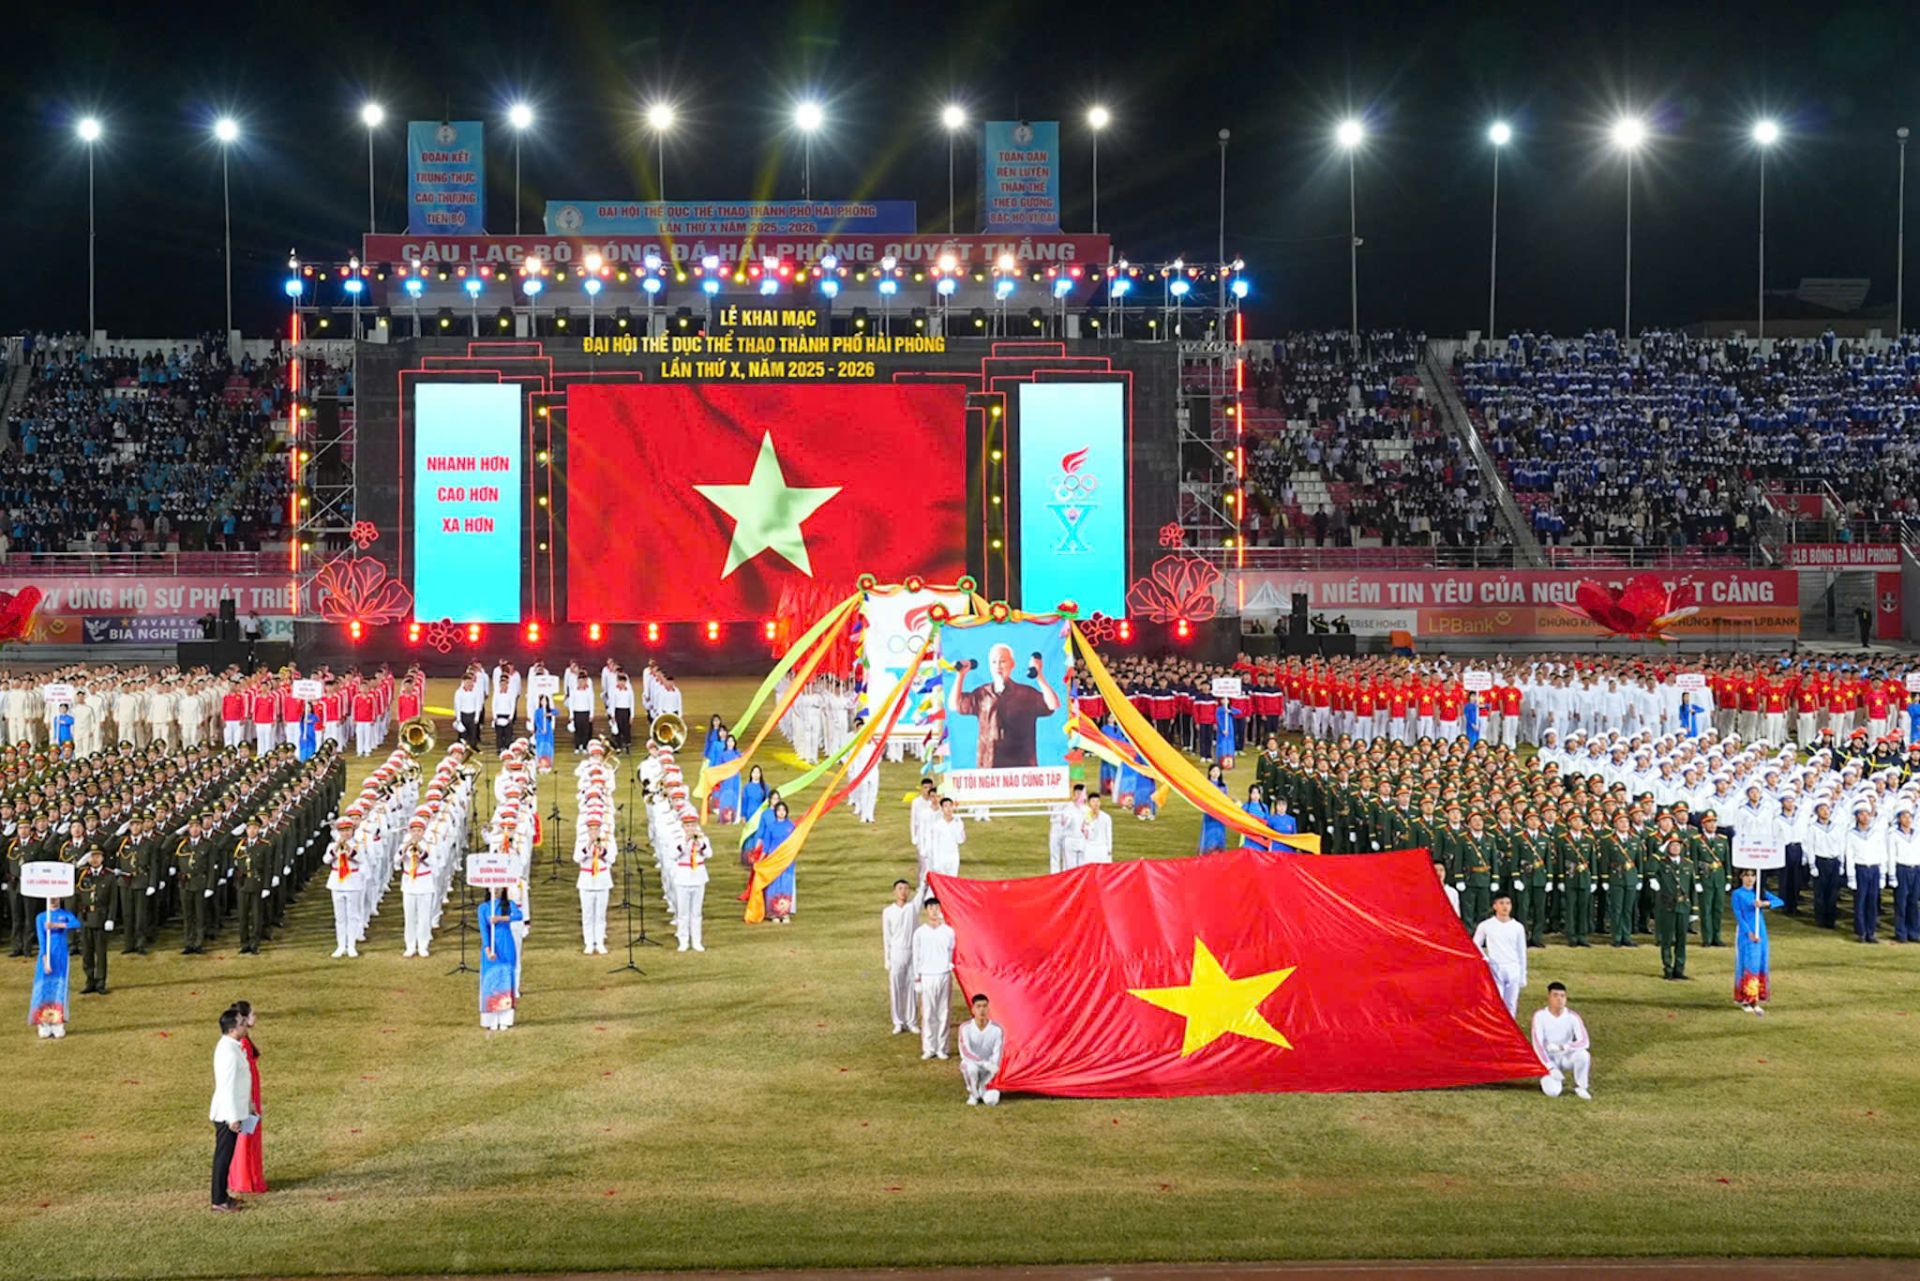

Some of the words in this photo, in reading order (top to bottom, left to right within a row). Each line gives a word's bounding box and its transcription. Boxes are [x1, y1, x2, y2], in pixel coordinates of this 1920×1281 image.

[416, 193, 434, 203] CAO
[717, 206, 745, 217] THAO
[710, 223, 717, 233] X
[750, 223, 777, 233] 2025
[789, 223, 816, 233] 2026
[402, 241, 460, 262] CÂU
[670, 240, 708, 262] ĐÁ
[776, 239, 875, 261] PHÒNG
[720, 305, 738, 326] LỄ
[742, 310, 778, 326] KHAI
[782, 310, 817, 329] MẠC
[583, 336, 609, 356] ĐẠI
[613, 333, 638, 356] HỘI
[641, 329, 669, 353] THỂ
[672, 337, 701, 356] DỤC
[706, 329, 734, 353] THỂ
[737, 337, 775, 353] THAO
[779, 334, 829, 353] THÀNH
[832, 331, 864, 353] PHỐ
[866, 332, 891, 353] HẢI
[894, 333, 945, 353] PHÒNG
[661, 357, 692, 378] LẦN
[696, 357, 726, 378] THỨ
[730, 361, 746, 380] X,
[748, 358, 785, 378] NĂM
[788, 361, 825, 378] 2025
[837, 361, 875, 378] 2026
[427, 456, 476, 471] NHANH
[480, 455, 509, 471] HƠN
[437, 487, 465, 502] CAO
[469, 486, 498, 502] HƠN
[442, 518, 460, 532] XA
[464, 516, 494, 532] HƠN
[1810, 546, 1834, 563] BÓNG
[1387, 583, 1424, 603] TIN
[1430, 578, 1473, 603] YÊU
[1480, 575, 1526, 603] CỦA
[1711, 575, 1774, 602] CẢNG
[119, 584, 148, 613] HỘ
[154, 585, 185, 613] SỰ
[189, 583, 244, 609] PHÁT
[1428, 616, 1495, 633] LPBank
[1754, 617, 1797, 627] LPBANK
[109, 629, 134, 639] BIA
[182, 629, 204, 639] TIN
[964, 774, 976, 789] TÔI
